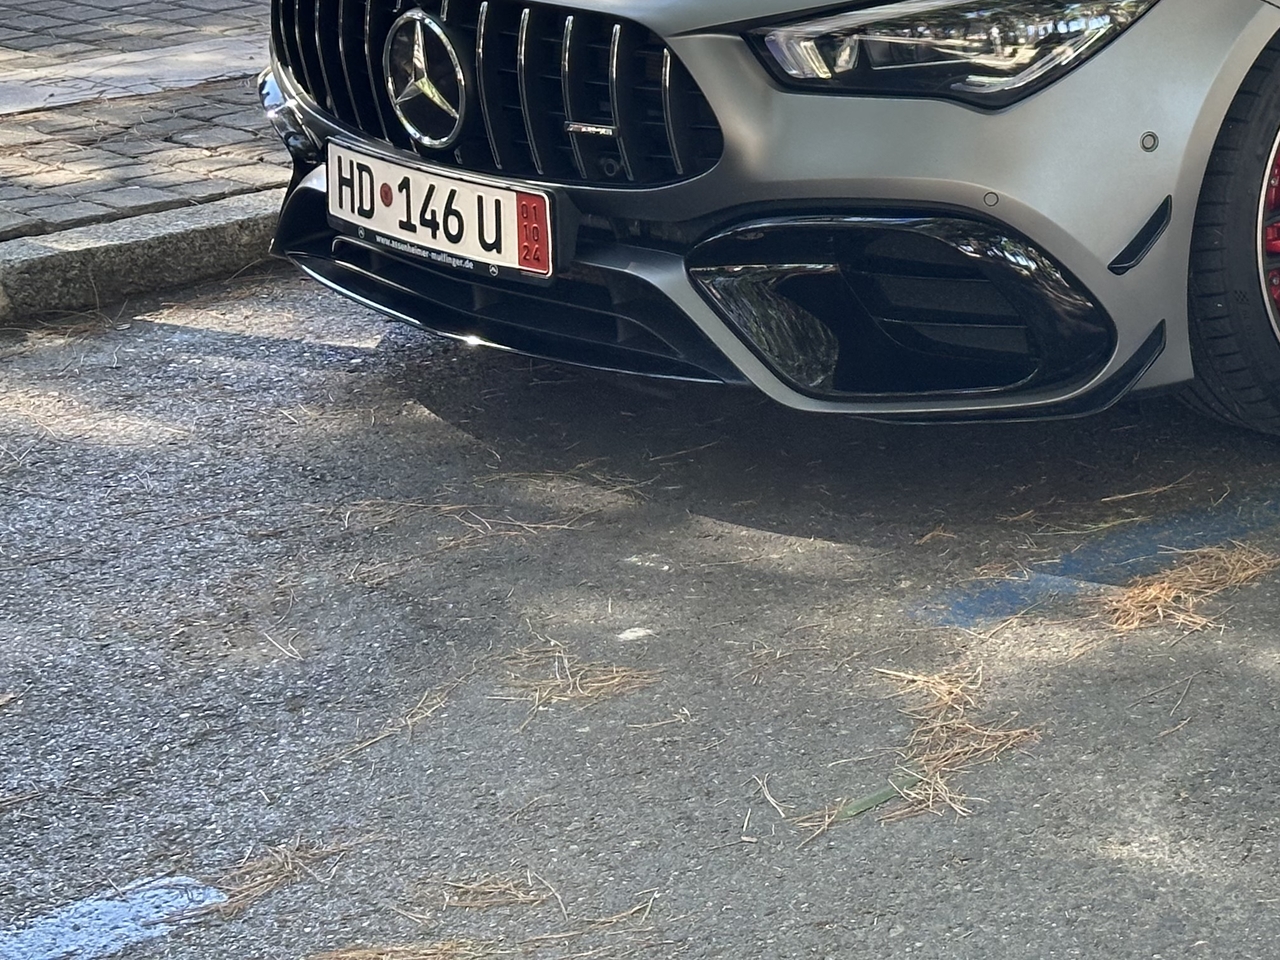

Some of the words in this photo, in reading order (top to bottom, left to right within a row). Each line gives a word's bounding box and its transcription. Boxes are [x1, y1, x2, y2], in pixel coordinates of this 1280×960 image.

[337, 155, 375, 219] HD
[397, 176, 465, 244] 146
[477, 194, 502, 255] U
[520, 201, 539, 220] 01
[522, 222, 541, 242] 10
[521, 243, 541, 262] 24
